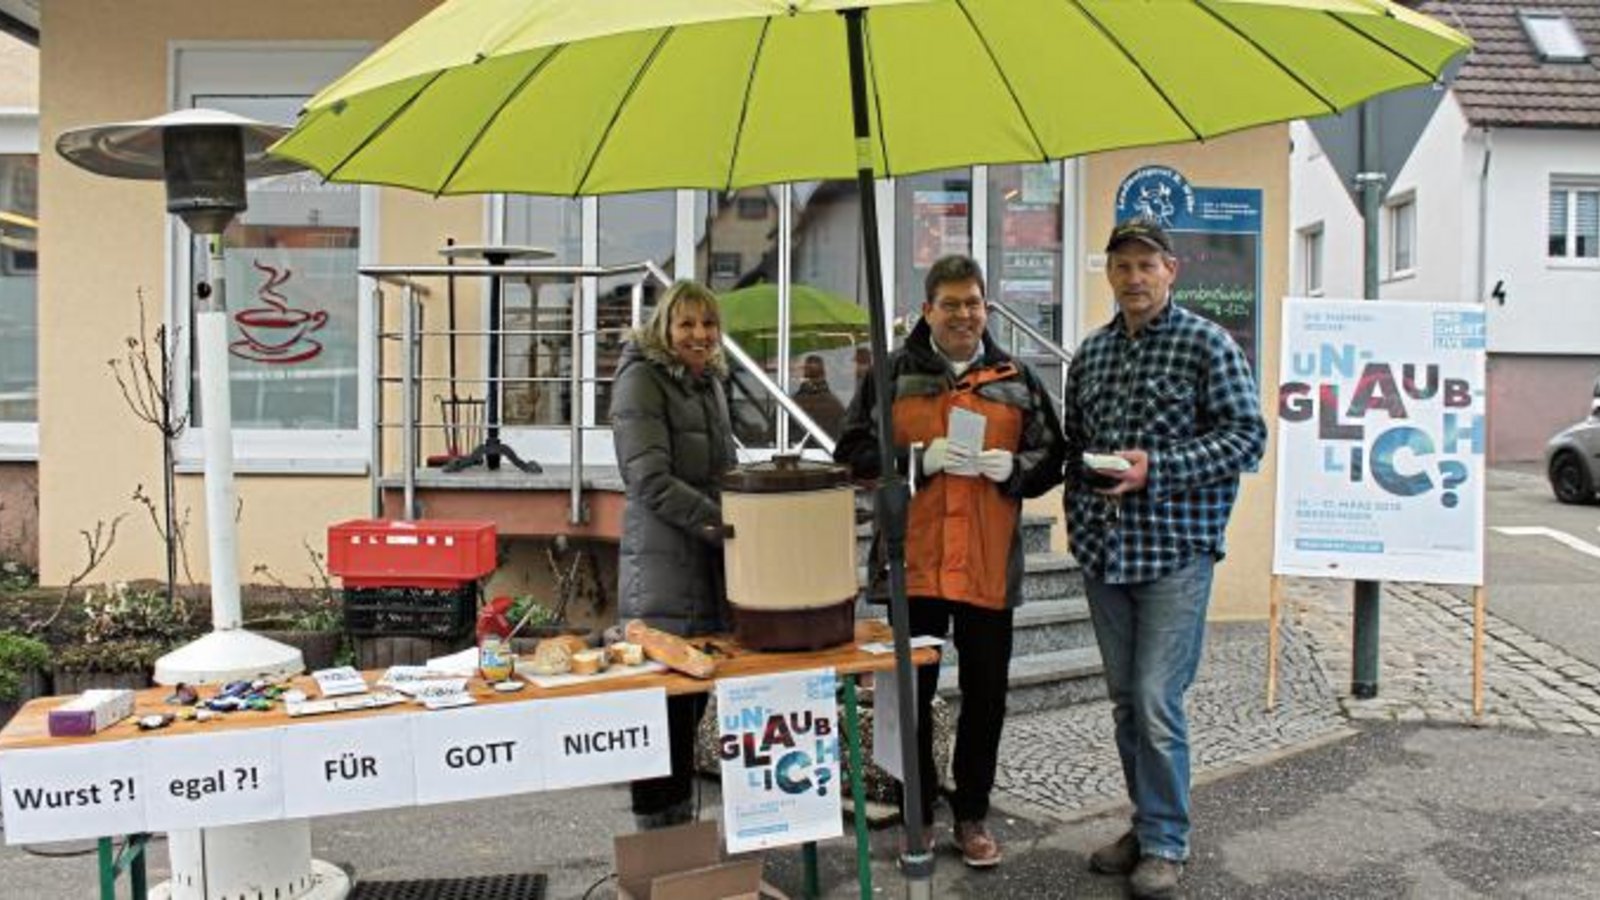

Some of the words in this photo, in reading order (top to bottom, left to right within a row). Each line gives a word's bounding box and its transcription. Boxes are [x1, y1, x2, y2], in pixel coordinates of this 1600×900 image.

[1492, 280, 1505, 306] 4
[445, 741, 516, 768] GOTT
[564, 725, 650, 755] NICHT!
[325, 753, 378, 781] FÜR
[13, 784, 101, 810] Wurst
[110, 777, 136, 802] ?!
[169, 769, 225, 800] egal
[234, 767, 259, 791] ?!
